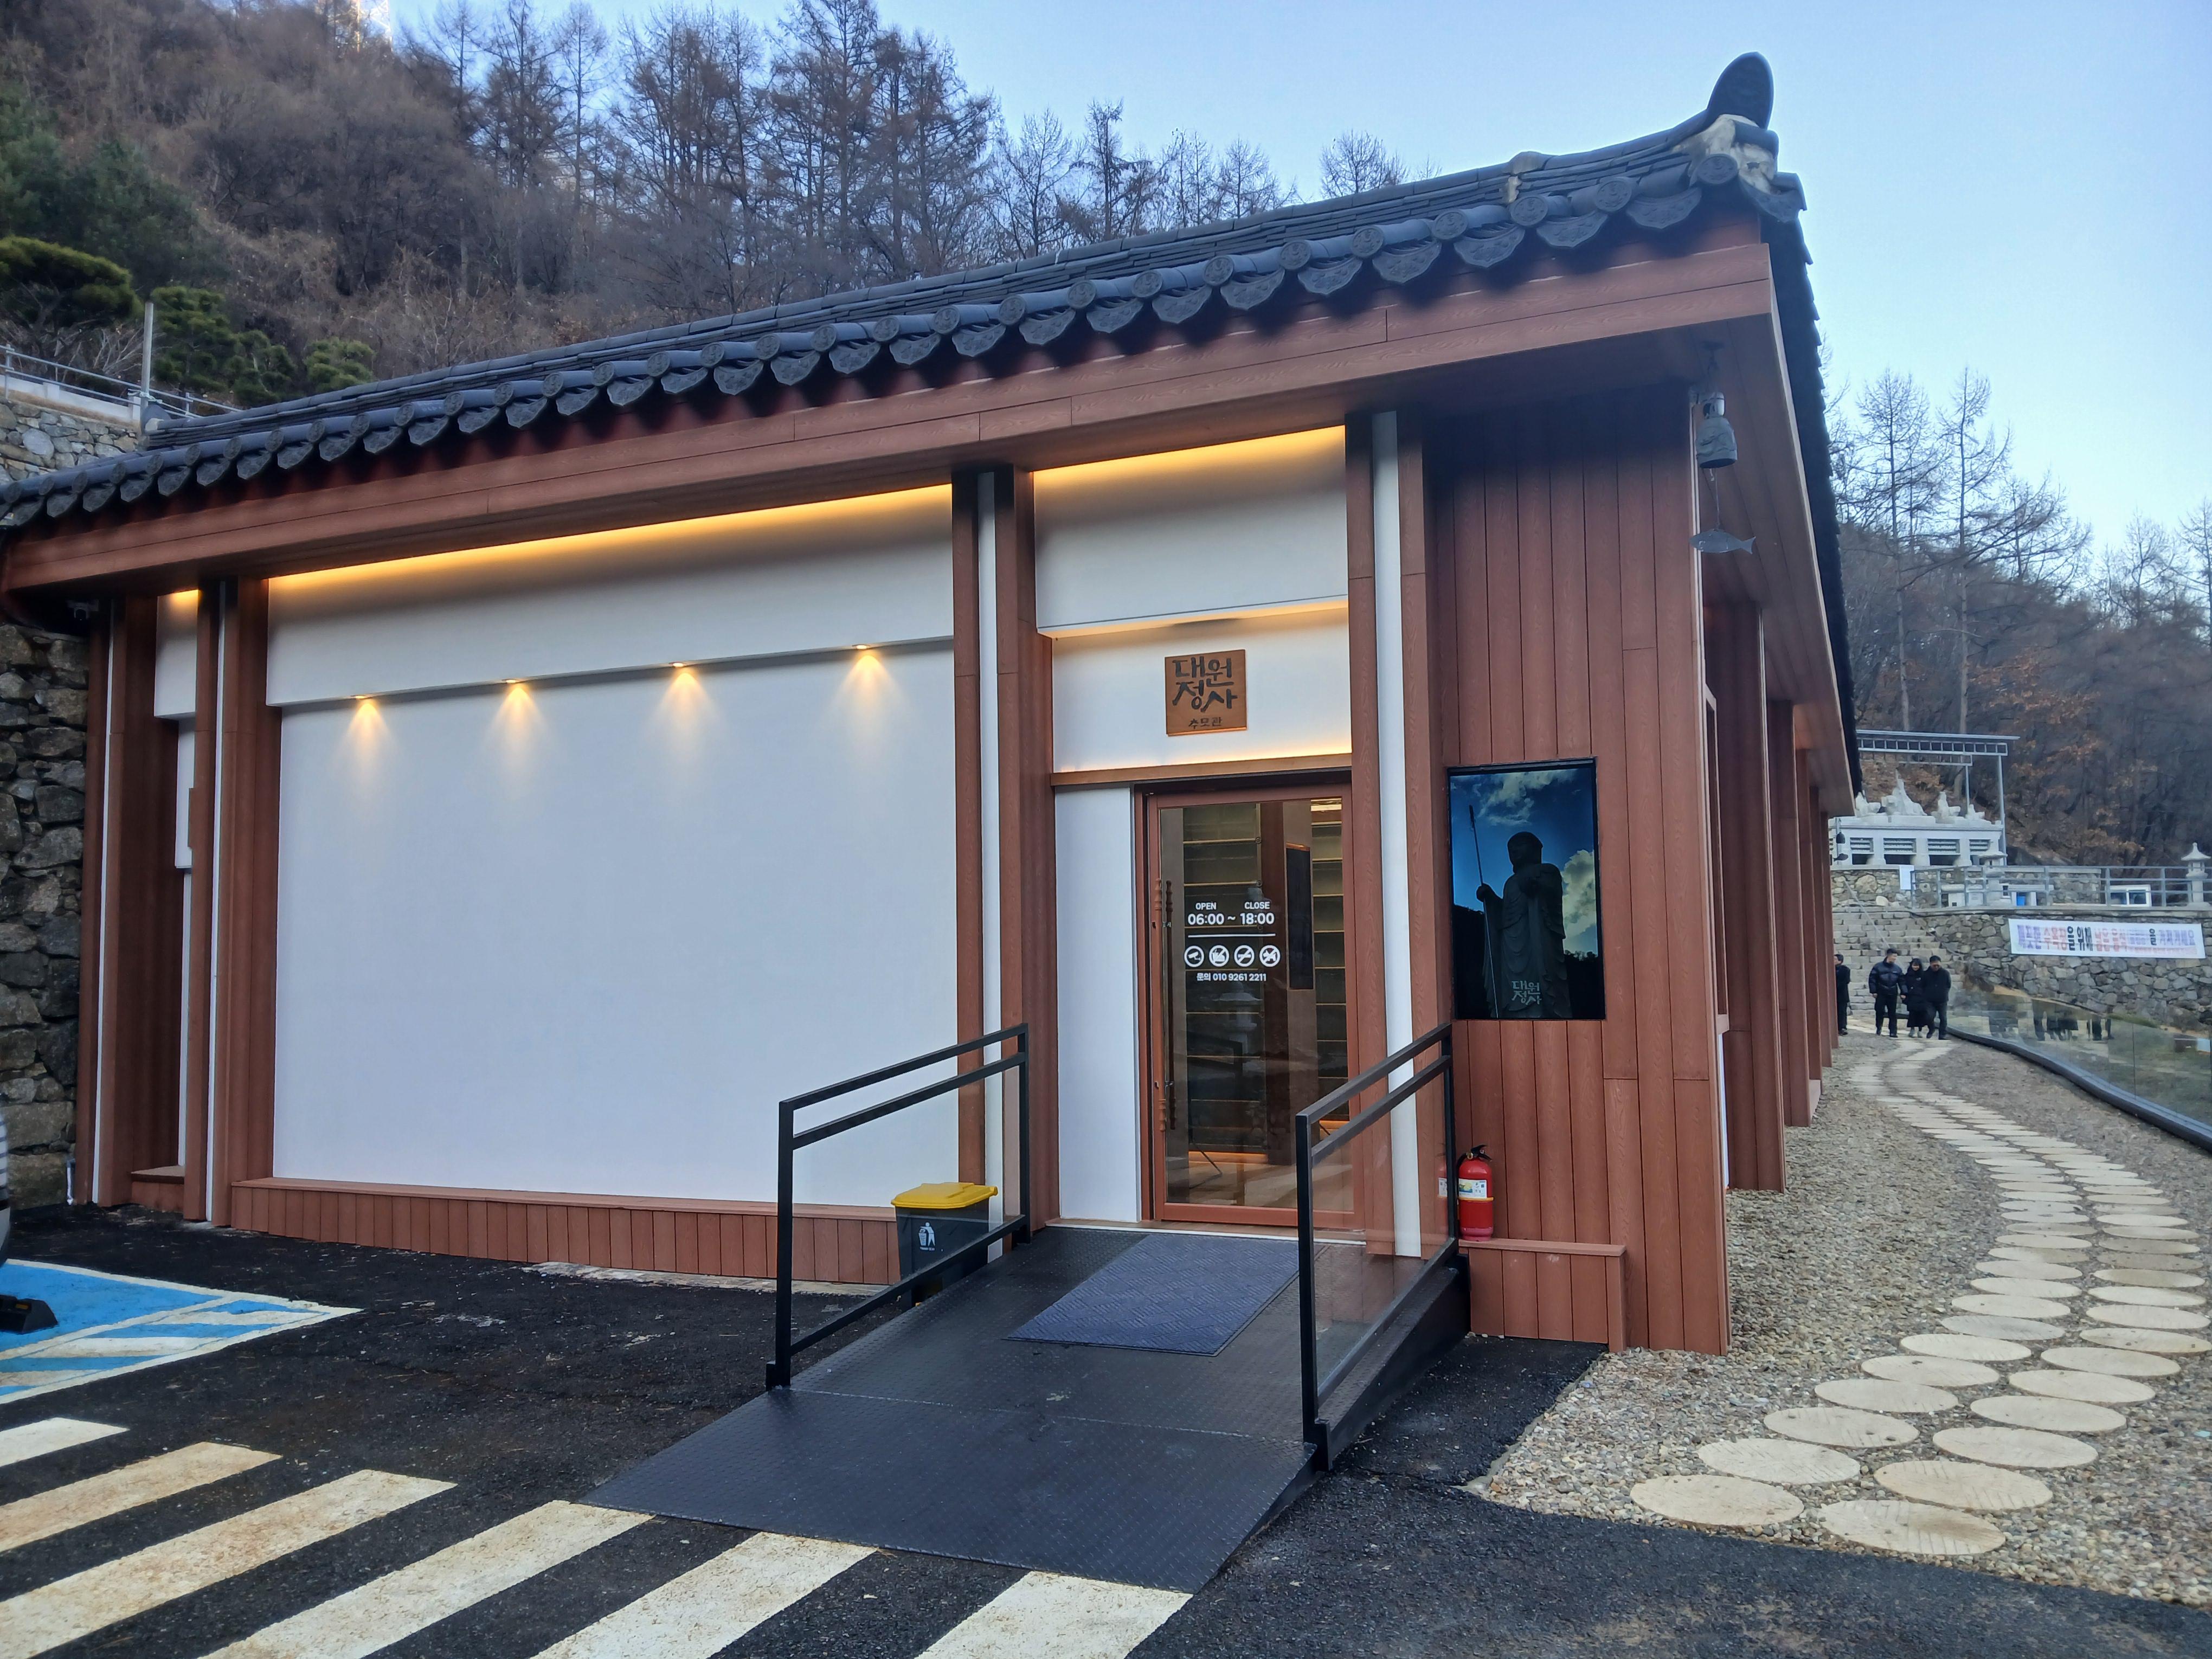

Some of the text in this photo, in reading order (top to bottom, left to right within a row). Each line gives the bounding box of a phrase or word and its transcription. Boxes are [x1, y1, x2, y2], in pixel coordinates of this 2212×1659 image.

[1172, 656, 1234, 687] 대원
[1172, 679, 1238, 712] 정사
[1188, 717, 1223, 729] 추모관
[1195, 901, 1270, 910] OPEN CLOSE
[1187, 913, 1225, 925] 06:00
[1240, 912, 1275, 925] 18:00
[2077, 927, 2093, 951] 위해
[1197, 973, 1266, 982] 문의 010 9261 2211
[1512, 980, 1541, 994] 대원
[1512, 991, 1542, 1006] 정사
